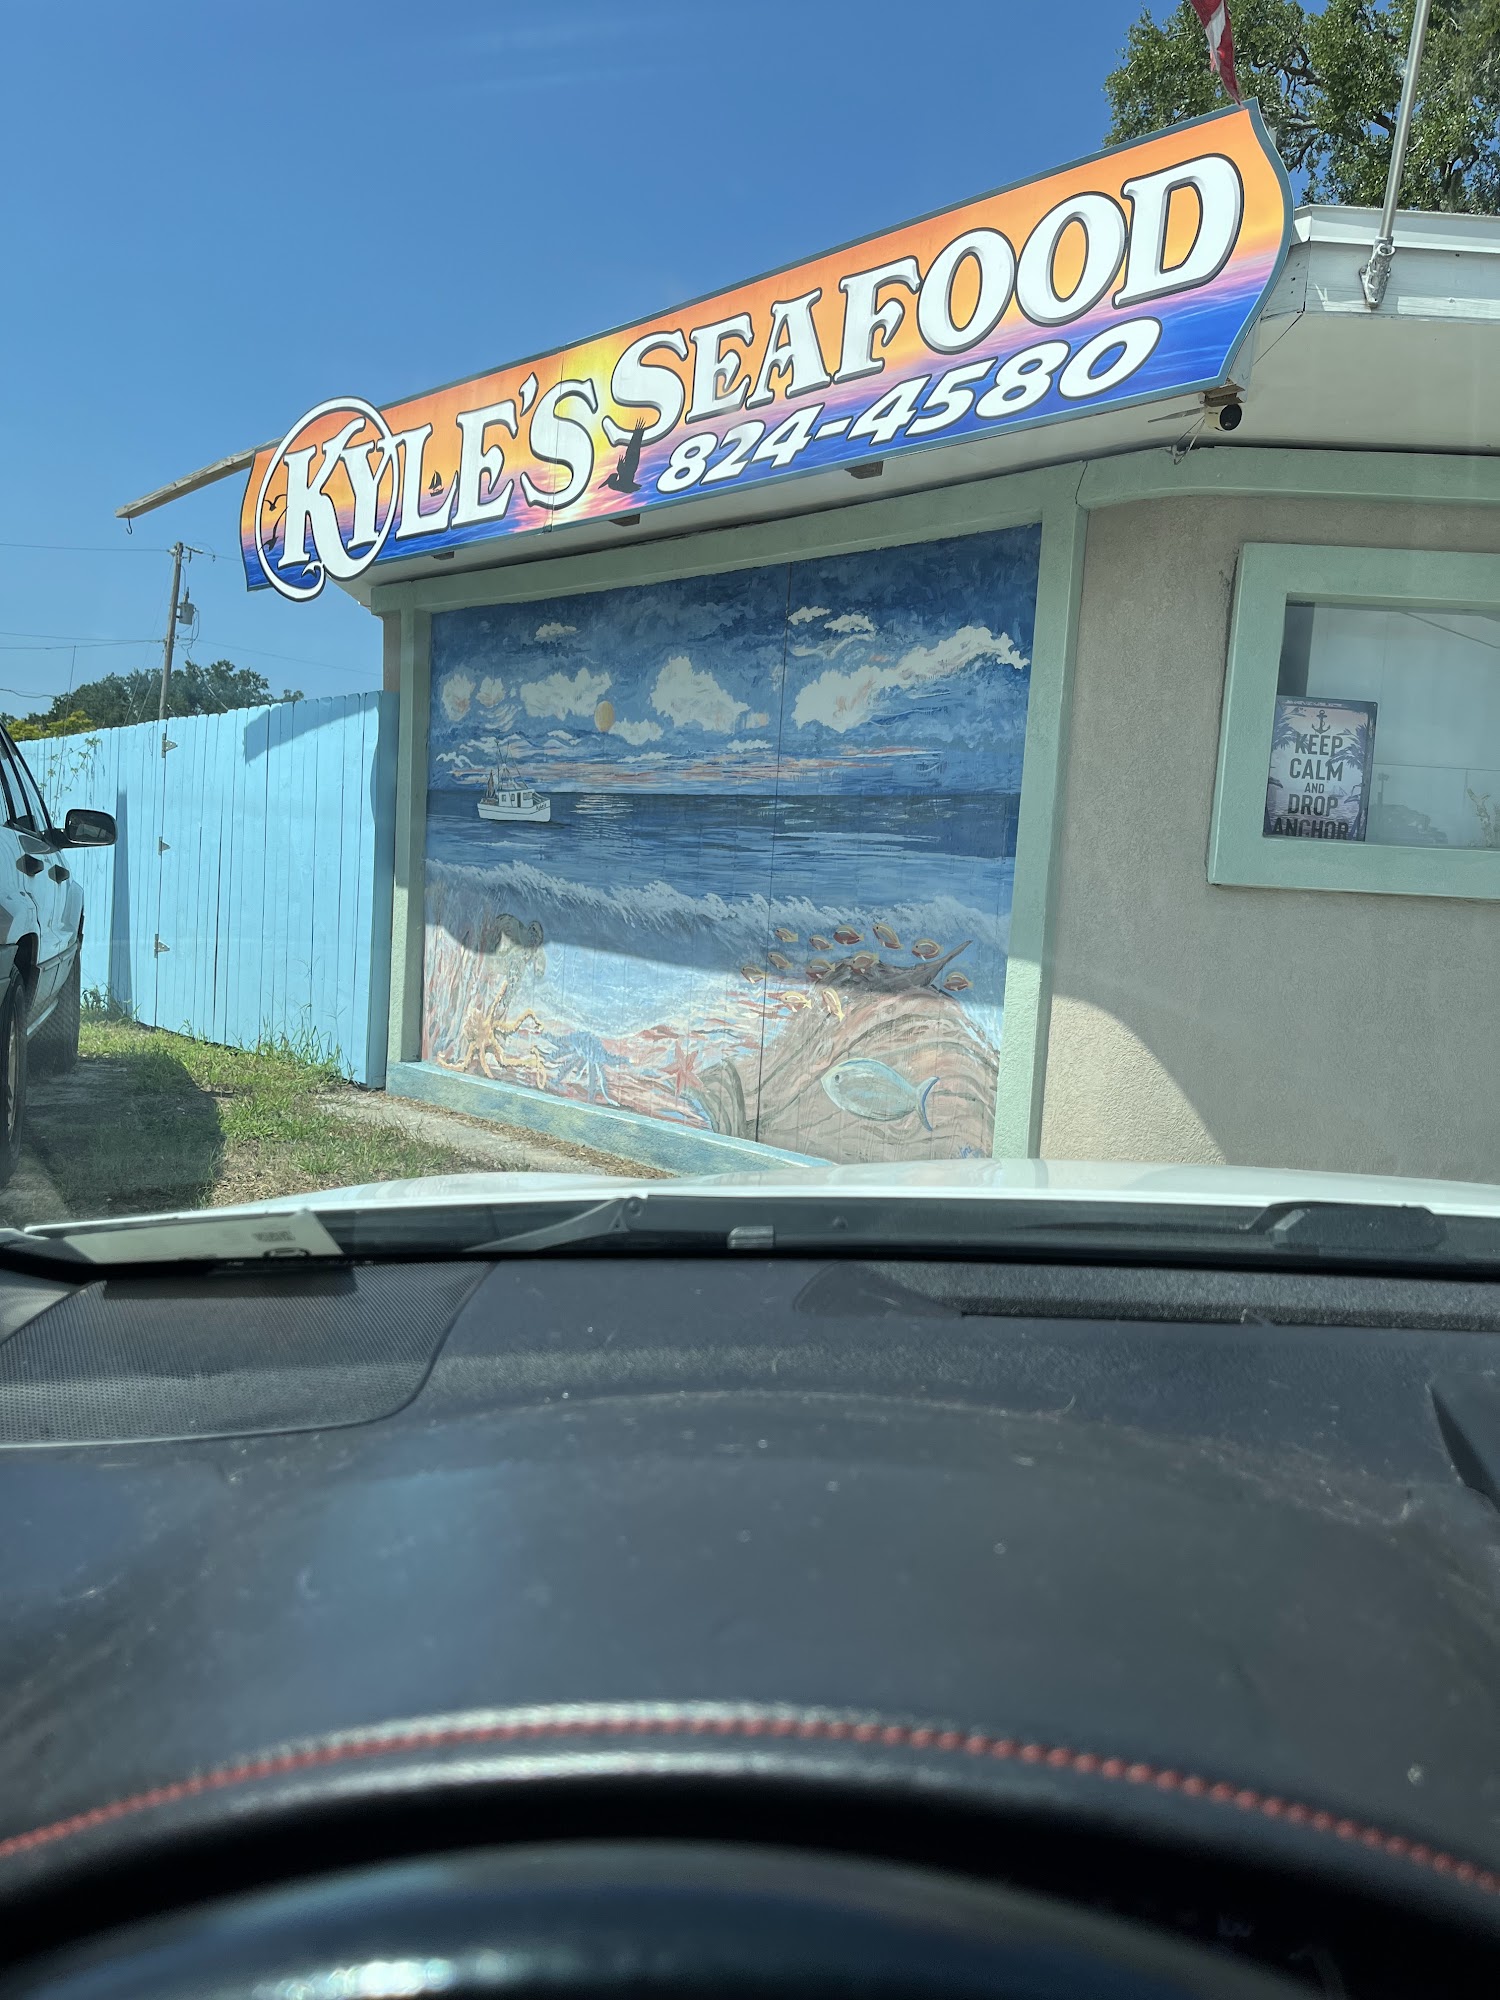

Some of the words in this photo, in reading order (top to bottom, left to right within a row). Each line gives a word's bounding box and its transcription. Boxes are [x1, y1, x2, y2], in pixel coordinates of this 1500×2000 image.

[256, 372, 600, 601] KYLE'S
[601, 152, 1245, 447] SEAFOOD
[656, 316, 1163, 494] 824-4580
[1294, 733, 1344, 757] KEEP
[1289, 758, 1344, 782] CALM
[1304, 782, 1325, 794] AND
[1287, 794, 1339, 817] DROP
[1272, 817, 1349, 840] ANCHOR
